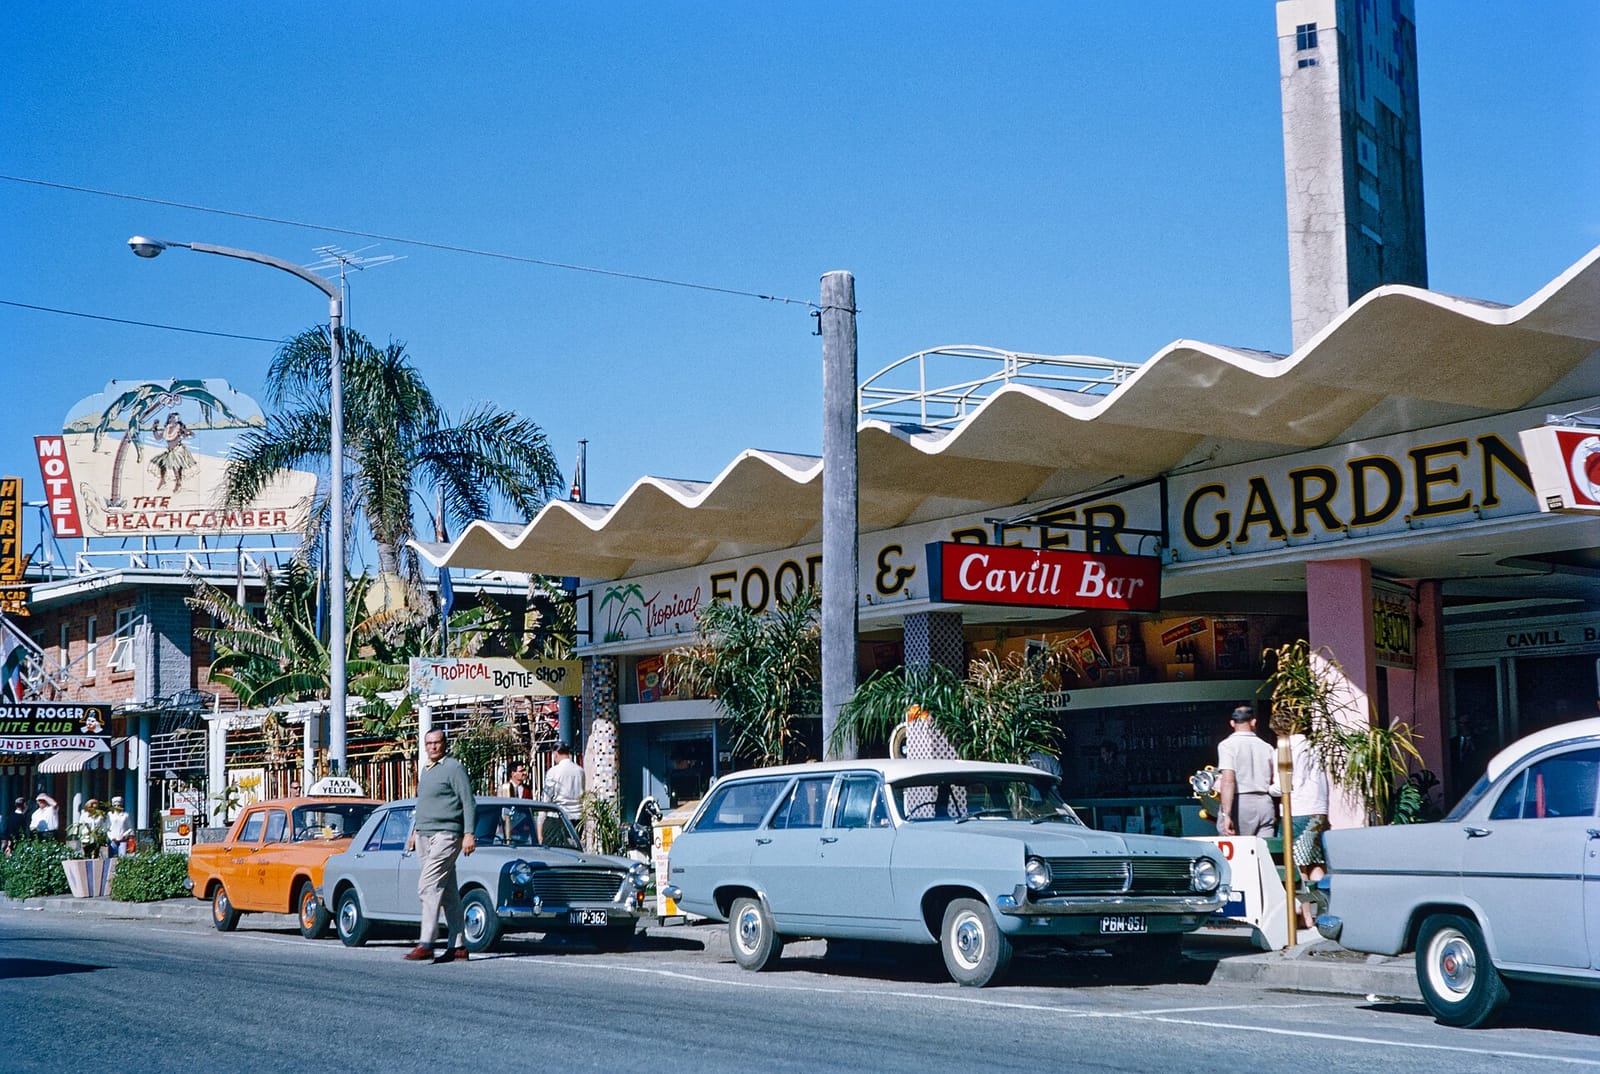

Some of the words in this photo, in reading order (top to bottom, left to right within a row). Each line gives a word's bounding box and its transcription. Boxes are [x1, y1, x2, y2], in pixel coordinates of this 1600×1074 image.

[39, 439, 77, 535] MOTEL
[1182, 431, 1537, 550] GARDEN
[132, 496, 172, 509] THE
[0, 480, 15, 575] HERTZ
[105, 511, 288, 530] BEACHCOMBER
[876, 544, 917, 597] &
[958, 553, 1061, 595] Cavill
[1076, 560, 1145, 600] Bar
[644, 586, 702, 628] Tropical
[1507, 630, 1566, 648] CAVILL
[1584, 626, 1600, 642] B
[493, 670, 533, 689] BOTTLE
[535, 666, 566, 684] SHOP
[36, 707, 84, 719] ROGER
[34, 721, 73, 733] CLUB
[321, 786, 358, 795] YELLOW
[329, 779, 351, 787] TAXI
